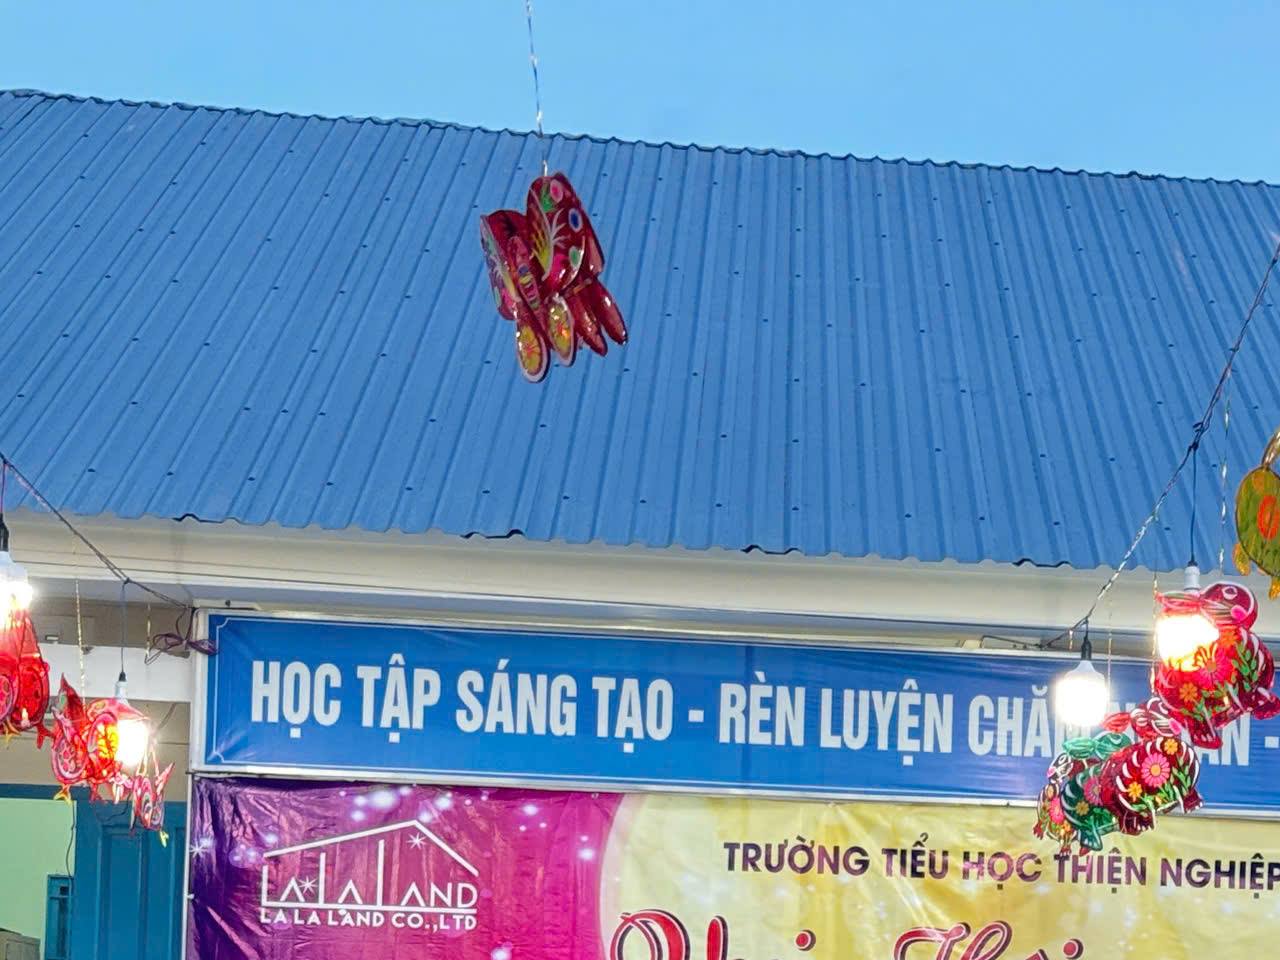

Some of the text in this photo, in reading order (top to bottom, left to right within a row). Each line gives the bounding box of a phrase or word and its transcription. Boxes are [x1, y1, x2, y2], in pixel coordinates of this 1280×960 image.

[251, 660, 342, 738] HỌC
[357, 653, 441, 743] TẬP
[456, 658, 578, 737] SÁNG
[592, 675, 673, 753] TẠO
[719, 671, 807, 748] RÈN
[820, 678, 953, 766] LUYỆN
[723, 835, 870, 876] TRƯỜNG
[881, 832, 949, 880] TIỂU
[962, 850, 1042, 891] HỌC
[1054, 847, 1147, 893] THIỆN
[260, 907, 287, 924] LA
[294, 909, 321, 925] LA
[327, 911, 385, 927] LAND
